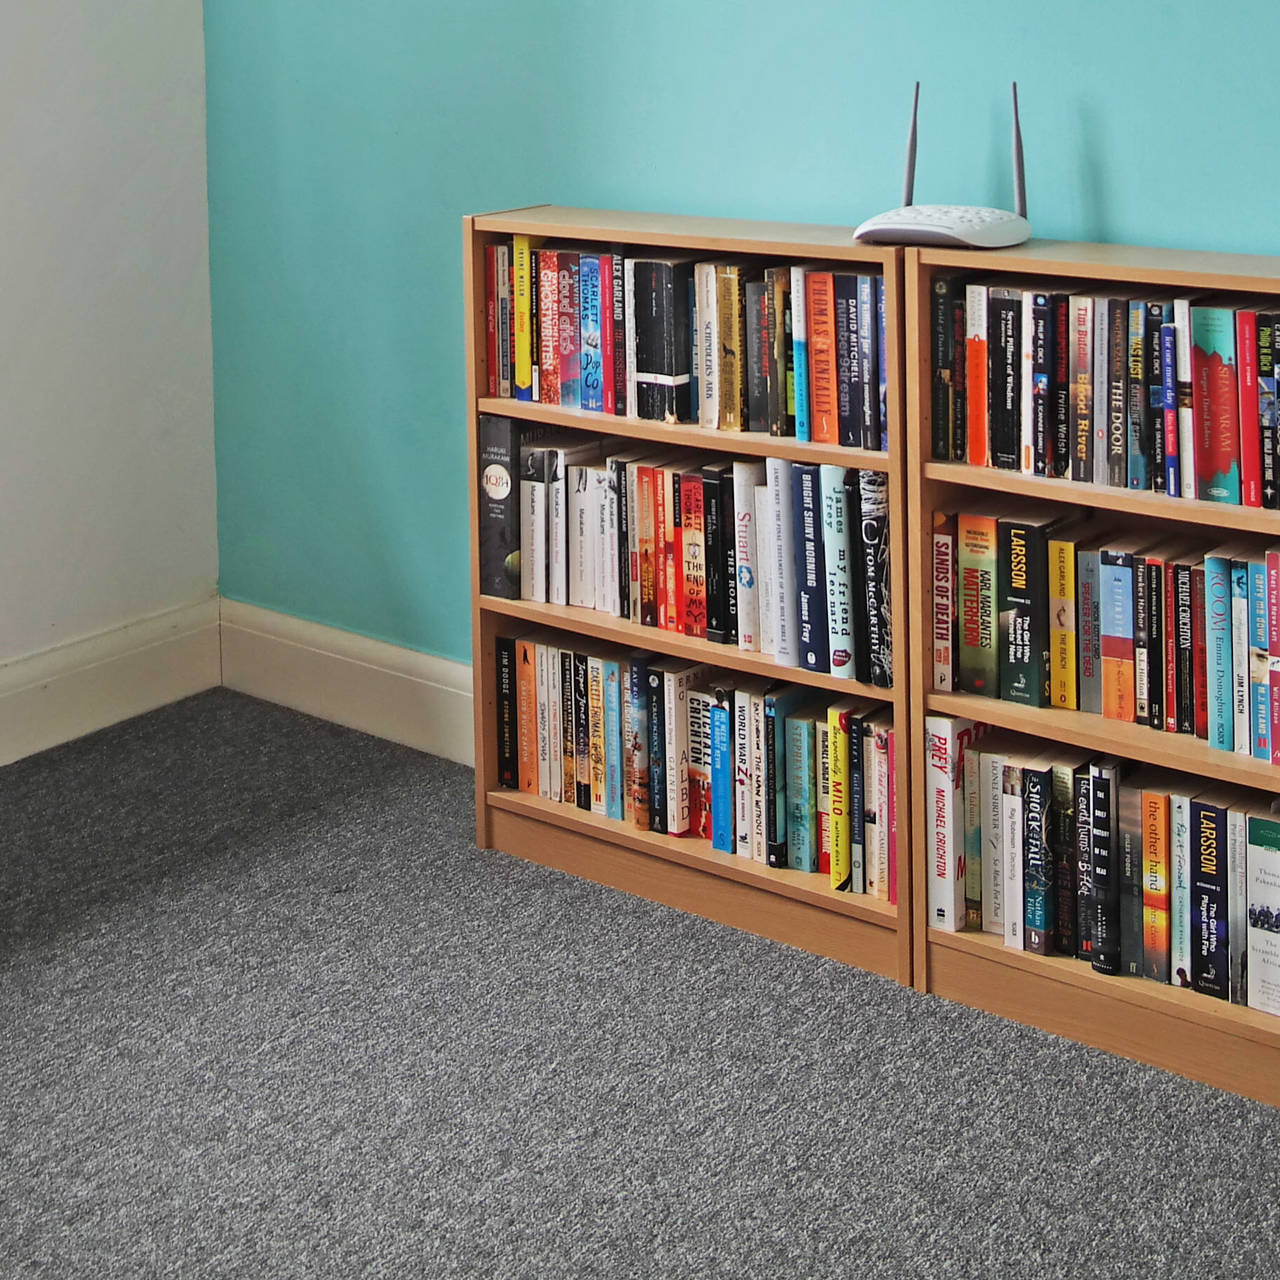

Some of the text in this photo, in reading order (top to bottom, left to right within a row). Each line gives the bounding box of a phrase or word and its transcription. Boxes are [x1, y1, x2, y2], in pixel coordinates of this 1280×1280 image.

[559, 270, 575, 355] cloud atlas
[581, 272, 590, 320] THOMAS
[590, 267, 599, 324] SCARLETT
[613, 254, 623, 321] ALEX GARLAND
[1077, 306, 1088, 327] Tim
[540, 270, 554, 370] GHOSTWRITTEN
[813, 279, 831, 417] THOMAS KENEALLY
[848, 299, 859, 383] DAVID MITCHELL
[1130, 336, 1142, 355] WAS
[705, 321, 714, 400] SCHINDLER'S ARK
[837, 299, 850, 417] number9dream
[1131, 356, 1142, 380] LOST
[1058, 391, 1067, 420] Irvine
[1077, 373, 1090, 414] Blood
[1111, 379, 1123, 455] THE DOOR
[1218, 367, 1232, 452] SHANTARAM
[1058, 422, 1067, 454] Welsh
[1077, 418, 1090, 460] River
[684, 489, 692, 528] THOMAS
[693, 485, 702, 531] SCARLETT
[802, 474, 817, 587] BRIGHT SHINY MORNING
[825, 495, 834, 529] frey
[832, 487, 845, 534] james
[685, 561, 703, 571] THE
[737, 512, 752, 563] Stuart
[1011, 529, 1026, 588] LARSSON
[686, 573, 704, 587] END
[727, 550, 736, 615] THE ROAD
[828, 572, 839, 636] leonard
[837, 549, 850, 637] my friend
[866, 547, 880, 653] TOM McCARTHY
[935, 541, 949, 641] SANDS OF DEATH
[964, 568, 980, 647] MATTERHORN
[1178, 570, 1191, 605] MICHAEL
[1211, 570, 1227, 632] ROOM
[800, 592, 811, 644] James Frey
[979, 570, 992, 649] KARL MARLANTES
[1081, 582, 1092, 677] SPEAKER FOR THE DEAD
[1179, 607, 1191, 649] CRICHTON
[1215, 637, 1224, 666] Emma
[576, 660, 588, 725] Jasper Jones
[591, 666, 602, 738] SCARLETT THOMAS
[1214, 669, 1225, 718] Donoghue
[1236, 674, 1245, 714] JIM LYNCH
[690, 697, 701, 765] CRICHTON
[737, 705, 751, 778] WORLD WAR Z
[932, 734, 948, 879] PREY MICHAEL CRICHTON
[1029, 783, 1042, 867] SHOCK FALL
[1149, 801, 1160, 820] the
[1149, 823, 1160, 857] other
[1200, 811, 1217, 875] LARSSON
[1149, 859, 1161, 891] hand
[1034, 895, 1042, 926] Nathan
[1200, 895, 1210, 956] Played with Fire
[1208, 903, 1216, 916] The
[1209, 935, 1217, 953] Who
